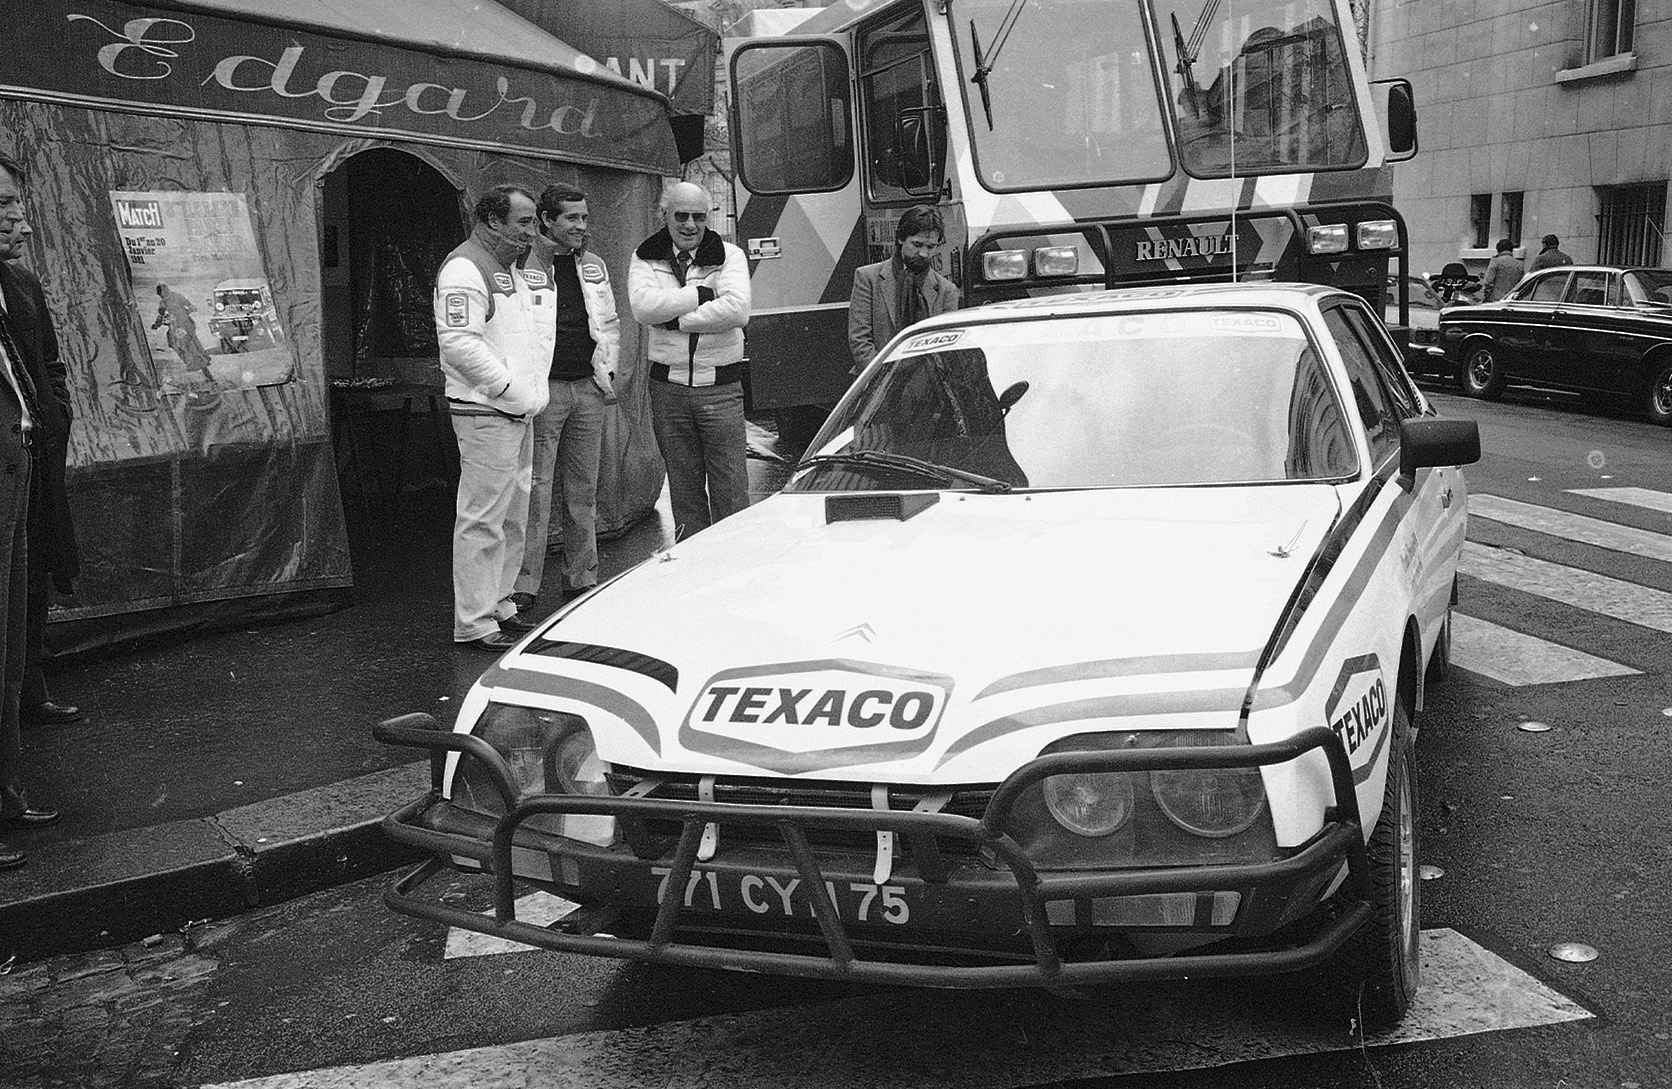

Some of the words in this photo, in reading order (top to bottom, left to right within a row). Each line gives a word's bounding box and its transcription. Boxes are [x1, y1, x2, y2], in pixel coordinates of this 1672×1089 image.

[66, 13, 602, 138] Edgard
[125, 237, 136, 247] Du
[146, 239, 156, 247] au
[156, 238, 166, 246] 20
[128, 246, 155, 255] Janvier
[1136, 234, 1239, 262] RENAULT
[1212, 317, 1277, 330] TEXACO
[907, 333, 959, 351] TEXACO
[702, 686, 935, 731] TEXACO
[1332, 677, 1386, 755] TEXACO
[651, 866, 722, 910] 771
[849, 882, 910, 925] 75
